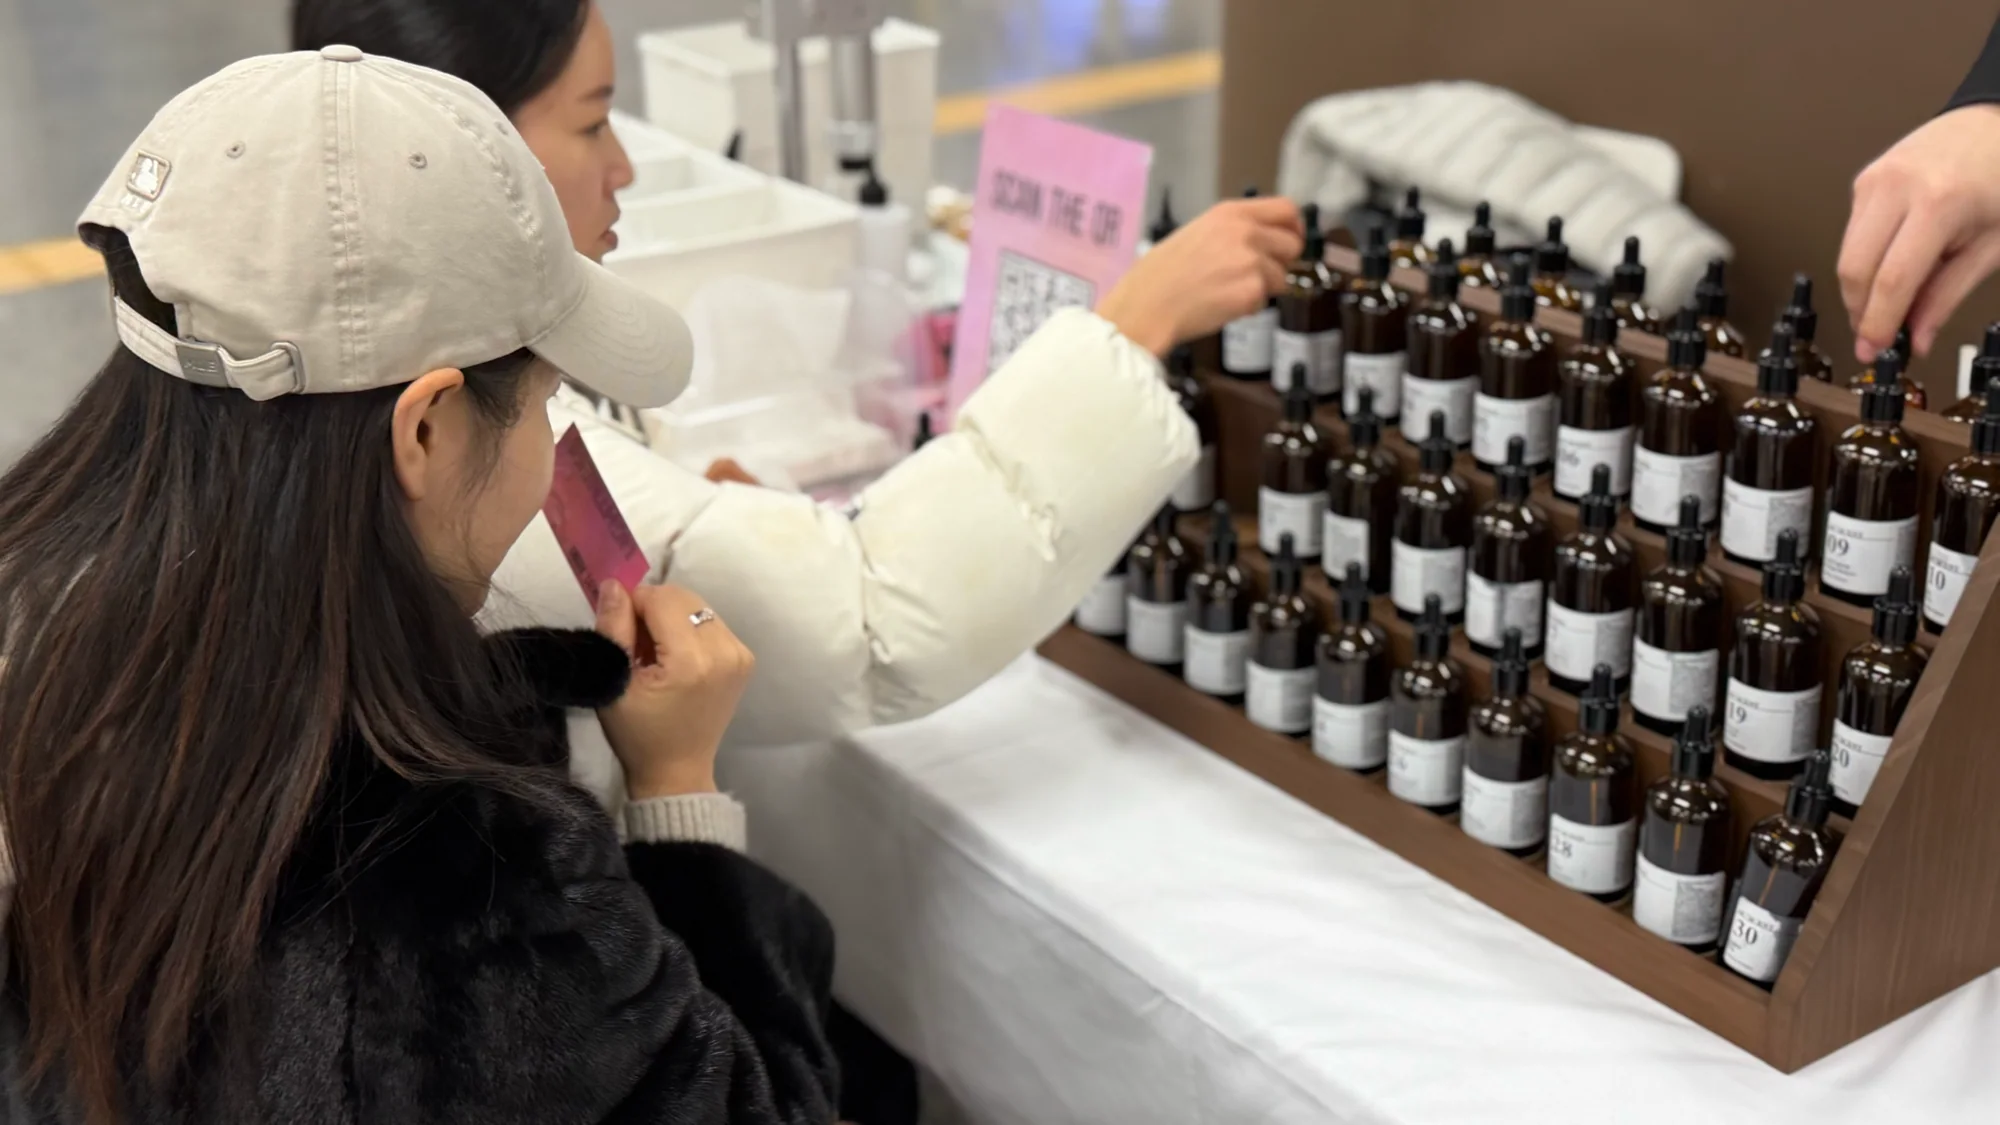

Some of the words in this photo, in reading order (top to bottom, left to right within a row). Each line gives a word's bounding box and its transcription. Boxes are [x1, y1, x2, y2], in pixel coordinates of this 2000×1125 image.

[990, 169, 1043, 223] SCAN
[1049, 185, 1087, 238] THE
[1828, 534, 1849, 555] 09
[1929, 566, 1946, 591] 10
[1729, 701, 1747, 725] 19
[1832, 741, 1849, 768] 20
[1732, 919, 1757, 945] 30
